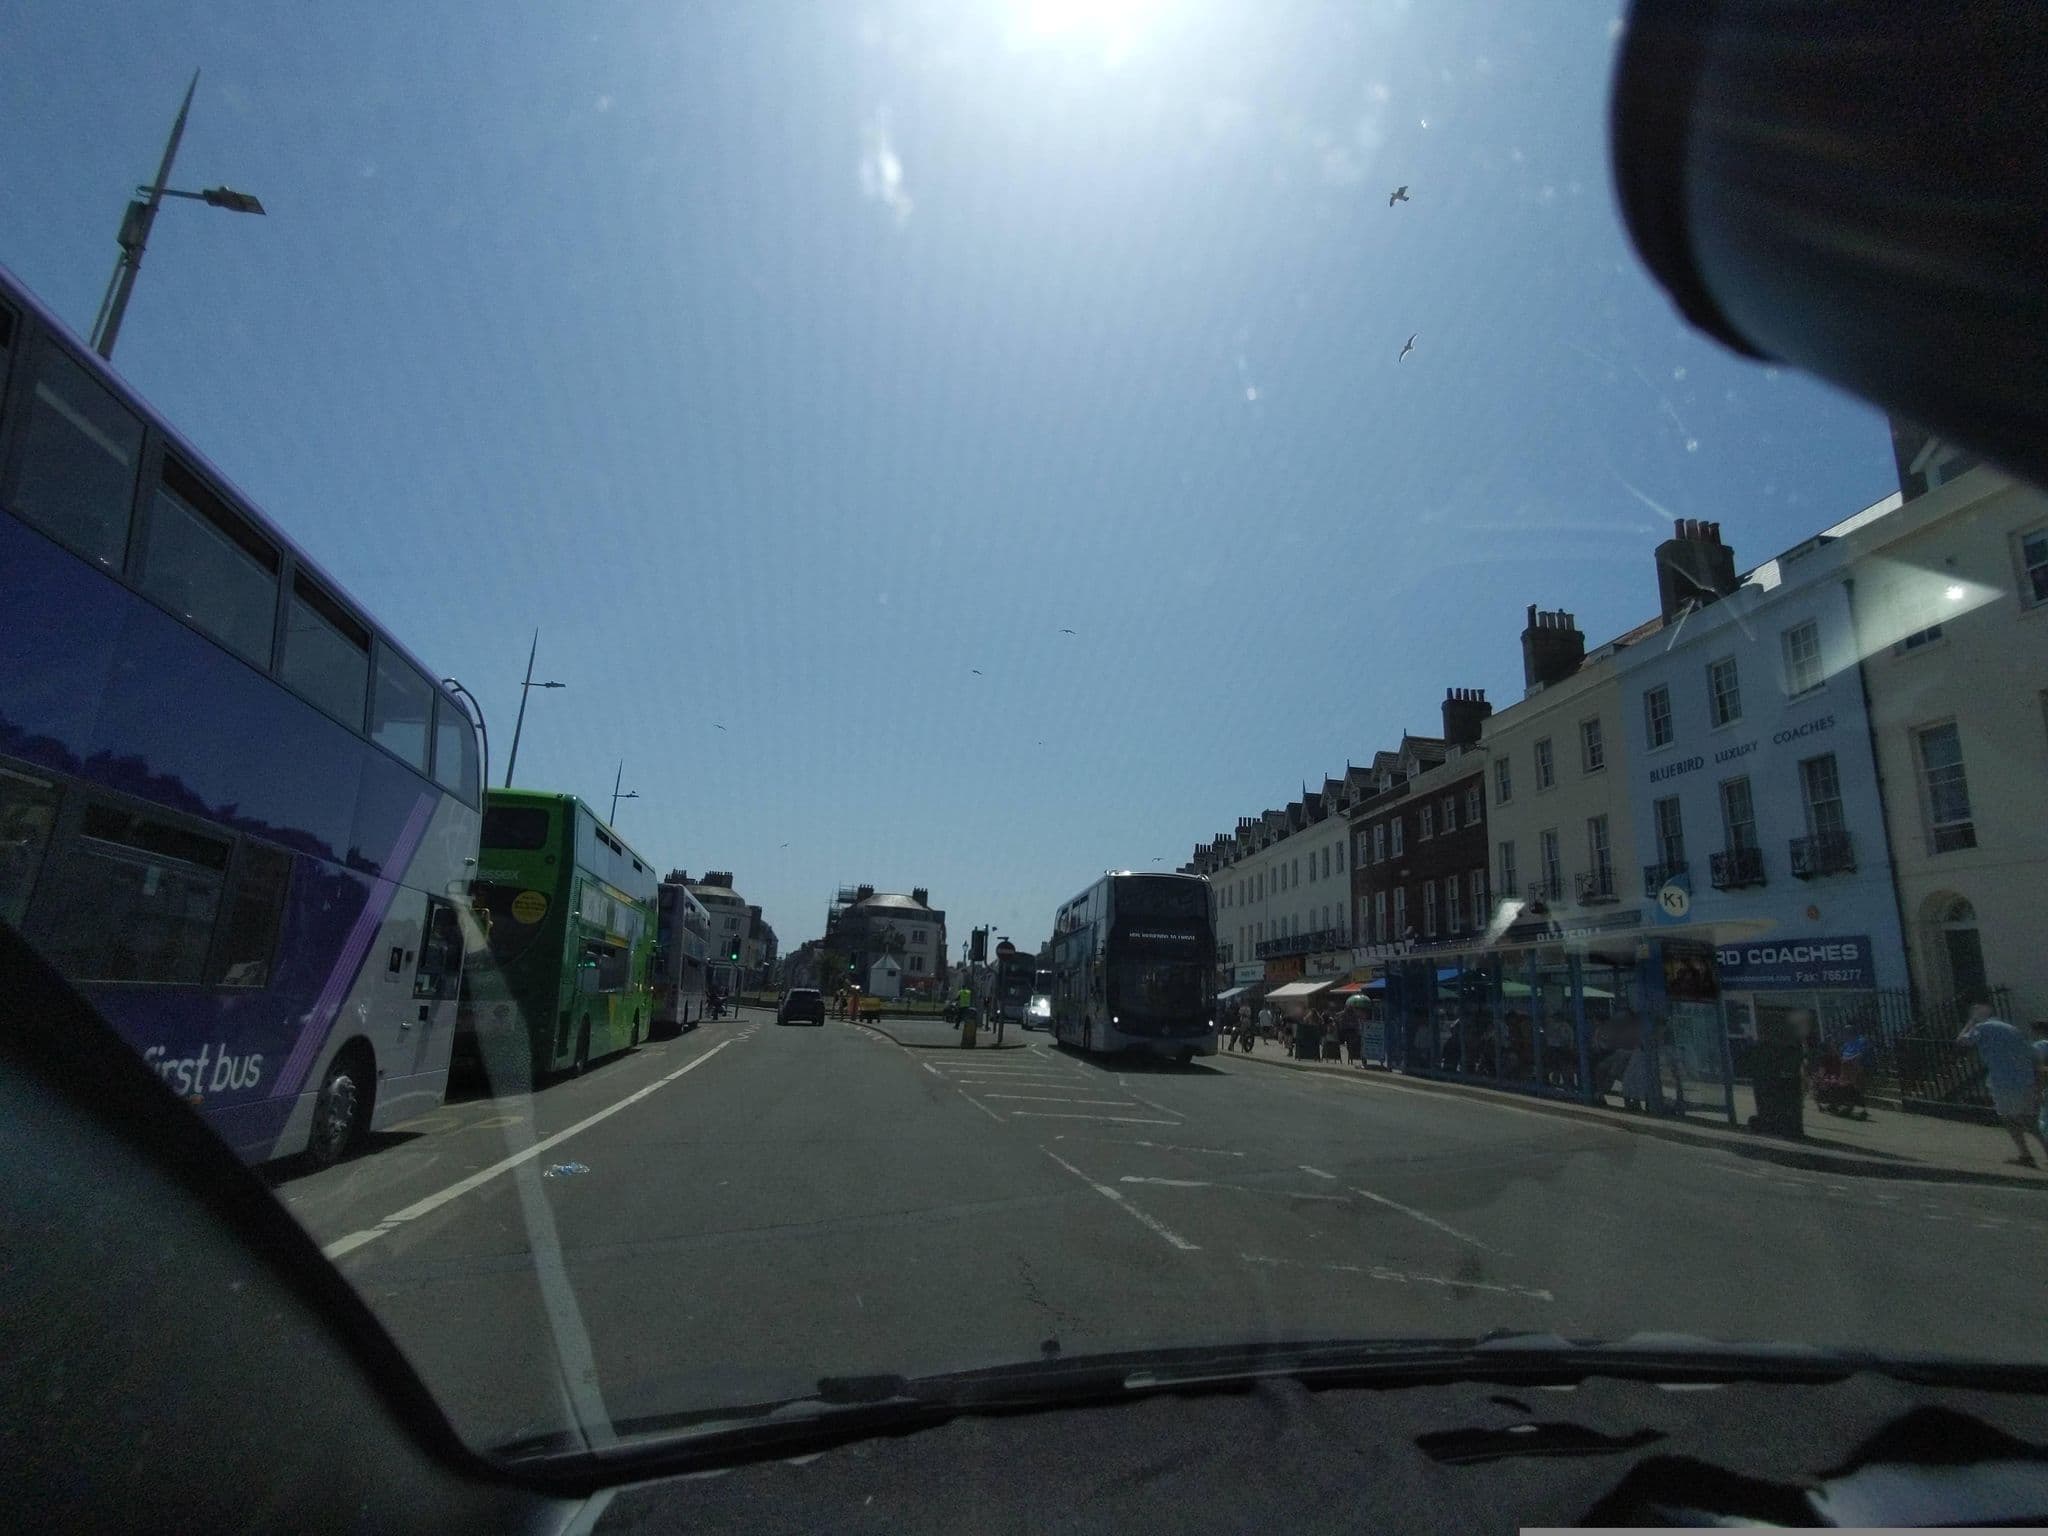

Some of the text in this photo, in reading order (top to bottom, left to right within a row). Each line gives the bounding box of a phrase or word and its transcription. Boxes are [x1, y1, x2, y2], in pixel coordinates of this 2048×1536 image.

[1650, 715, 1835, 783] BLUEBIRD LUXURY COACHES
[1663, 892, 1683, 908] K1
[1747, 943, 1858, 964] COACHES
[209, 1043, 264, 1092] bus
